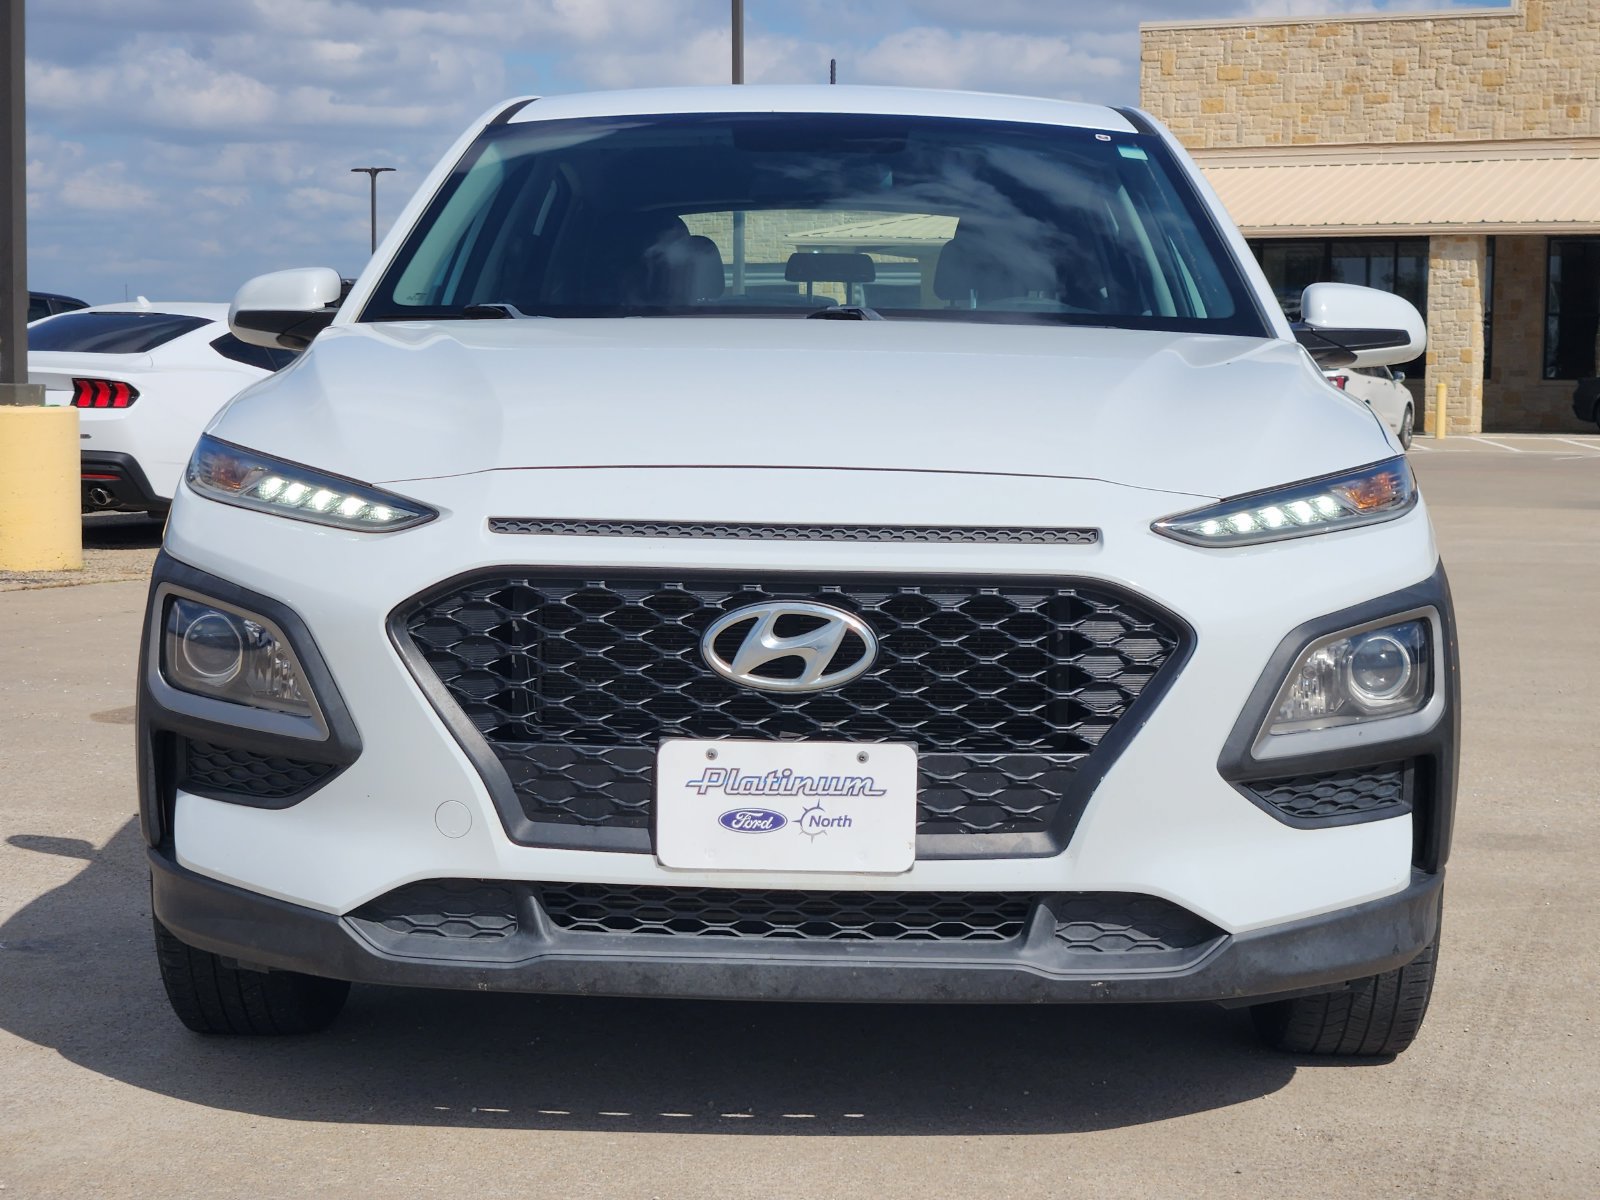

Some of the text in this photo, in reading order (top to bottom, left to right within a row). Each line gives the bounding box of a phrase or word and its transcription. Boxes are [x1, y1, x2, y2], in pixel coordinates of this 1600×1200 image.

[686, 767, 887, 797] Platinum
[731, 811, 852, 830] Ford North
